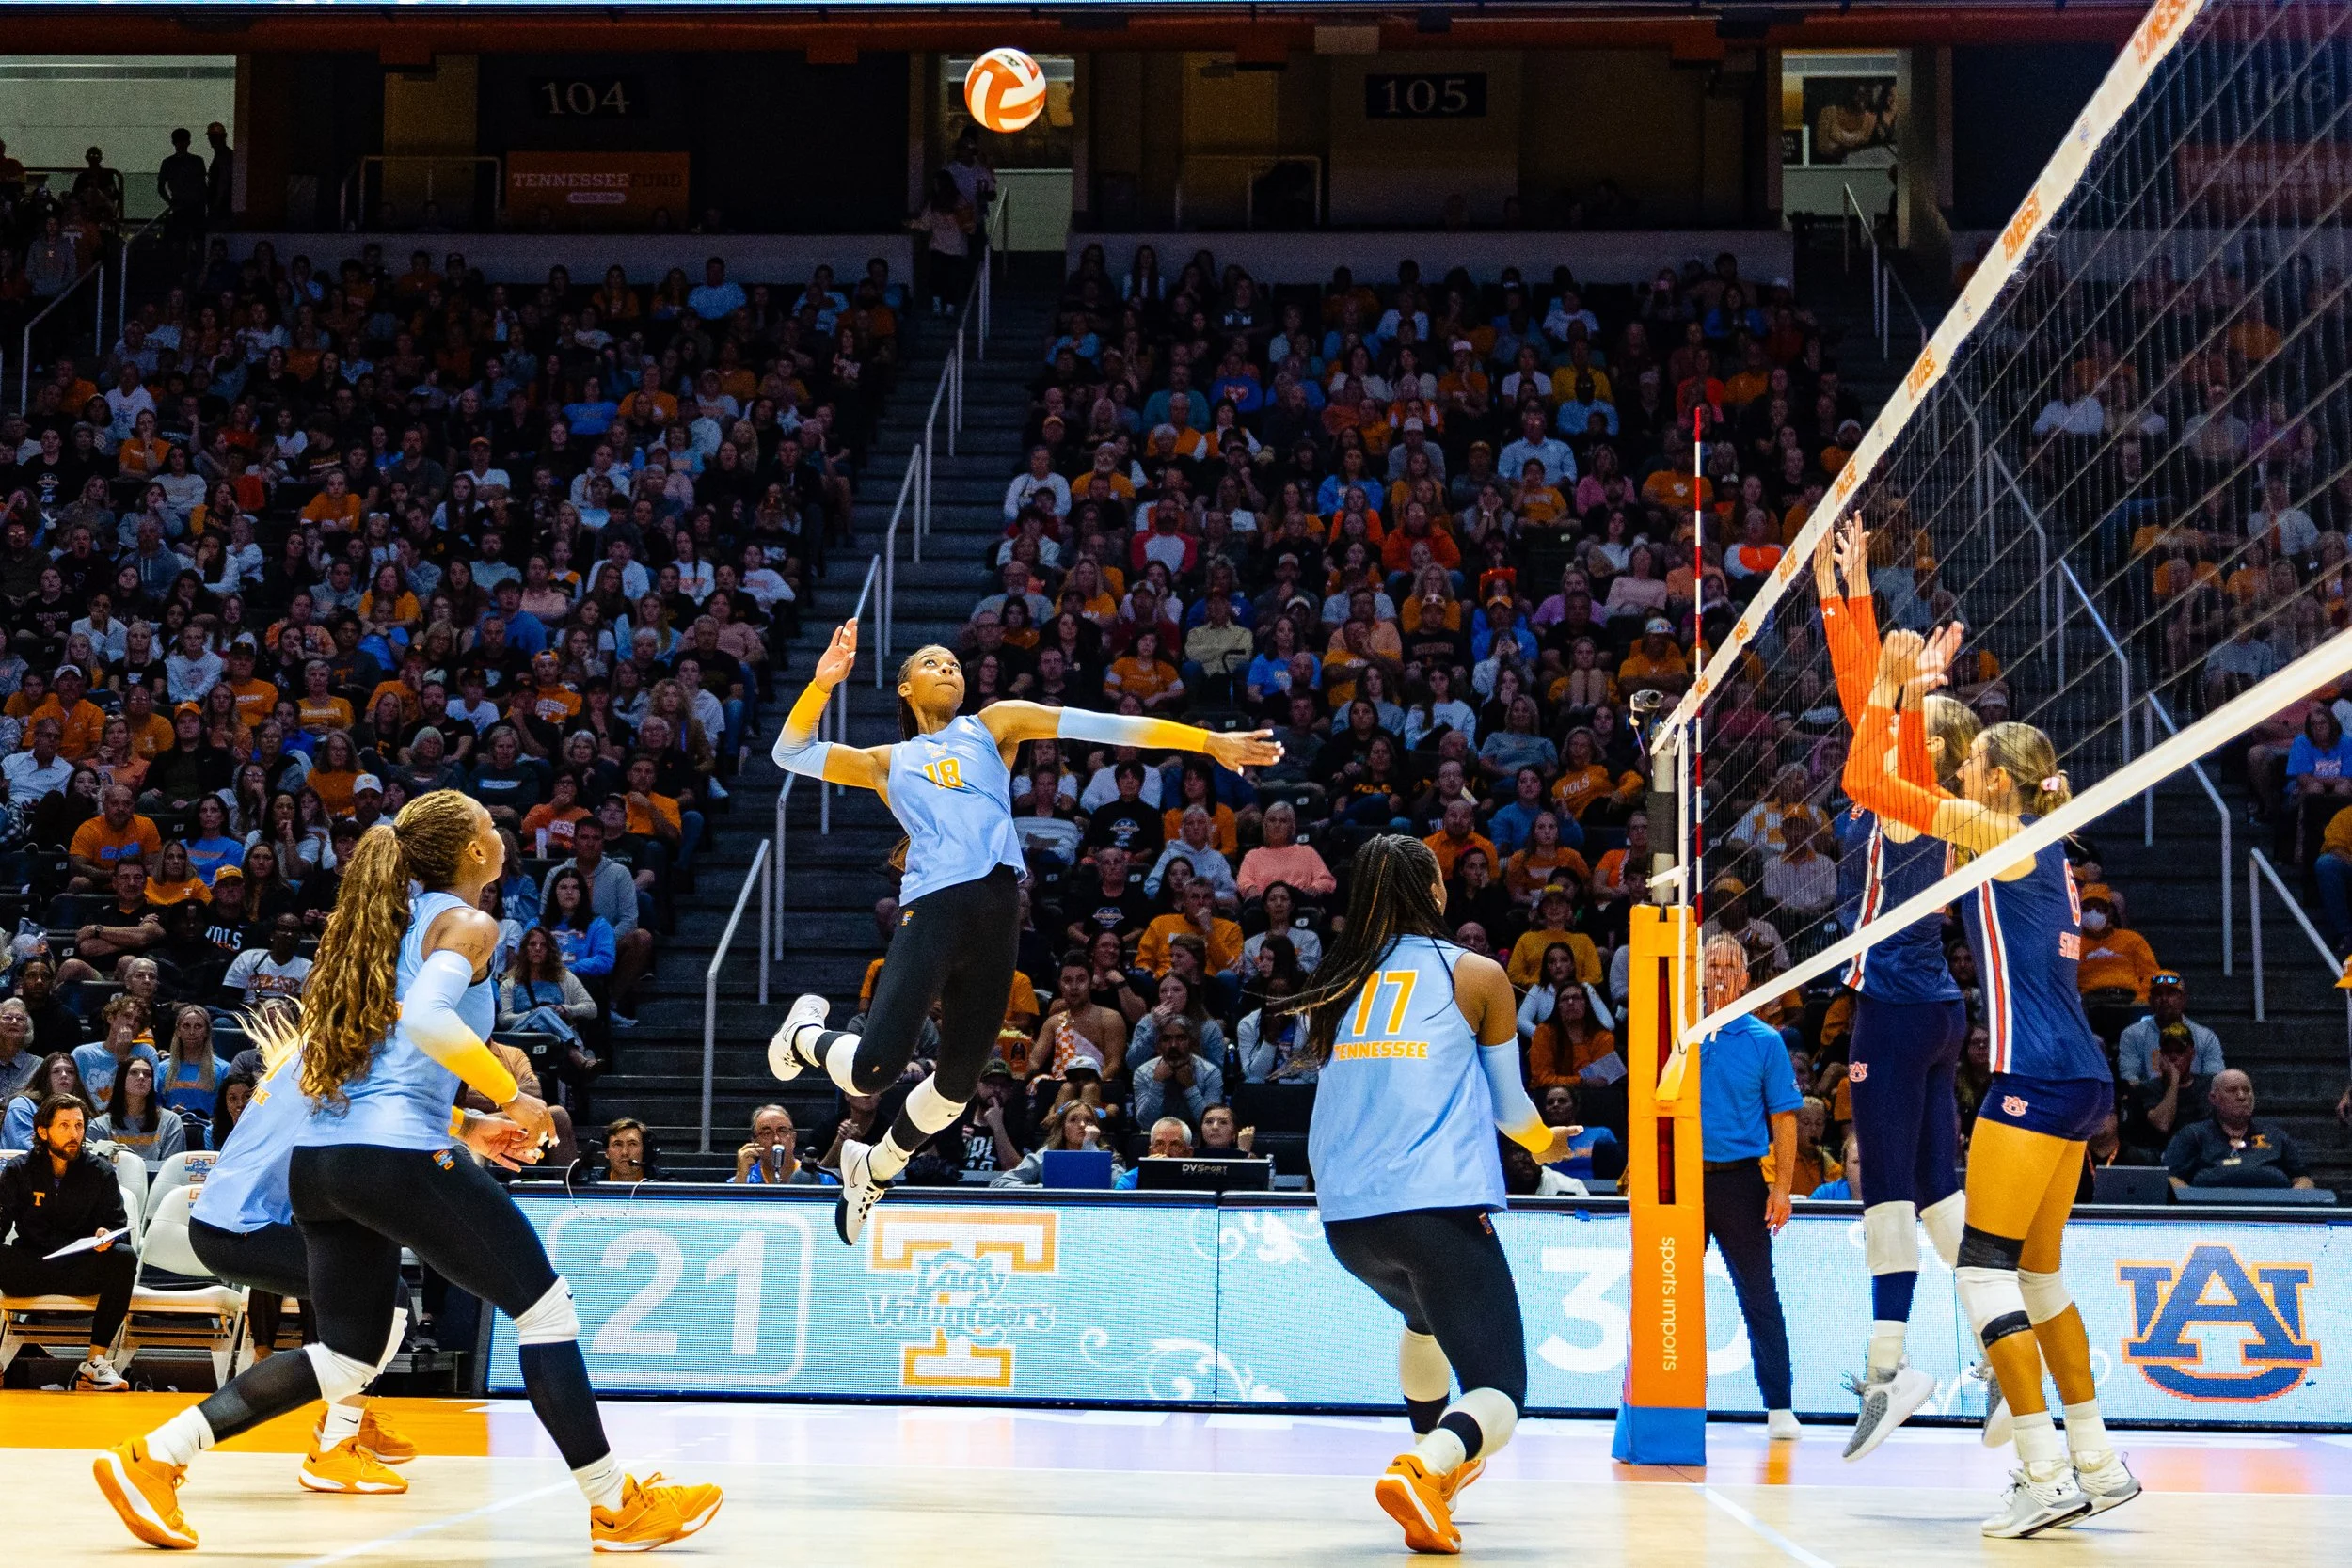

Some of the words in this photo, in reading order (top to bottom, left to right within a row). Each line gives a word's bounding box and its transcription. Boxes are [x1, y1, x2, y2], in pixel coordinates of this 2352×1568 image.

[541, 81, 631, 115] 104
[1380, 79, 1468, 114] 105
[923, 757, 964, 789] 18
[1352, 969, 1419, 1037] 17
[1333, 1040, 1430, 1062] TENNESSEE
[33, 1191, 45, 1207] T
[1659, 1237, 1677, 1295] sports
[592, 1230, 766, 1355] 21
[1660, 1298, 1678, 1370] imports
